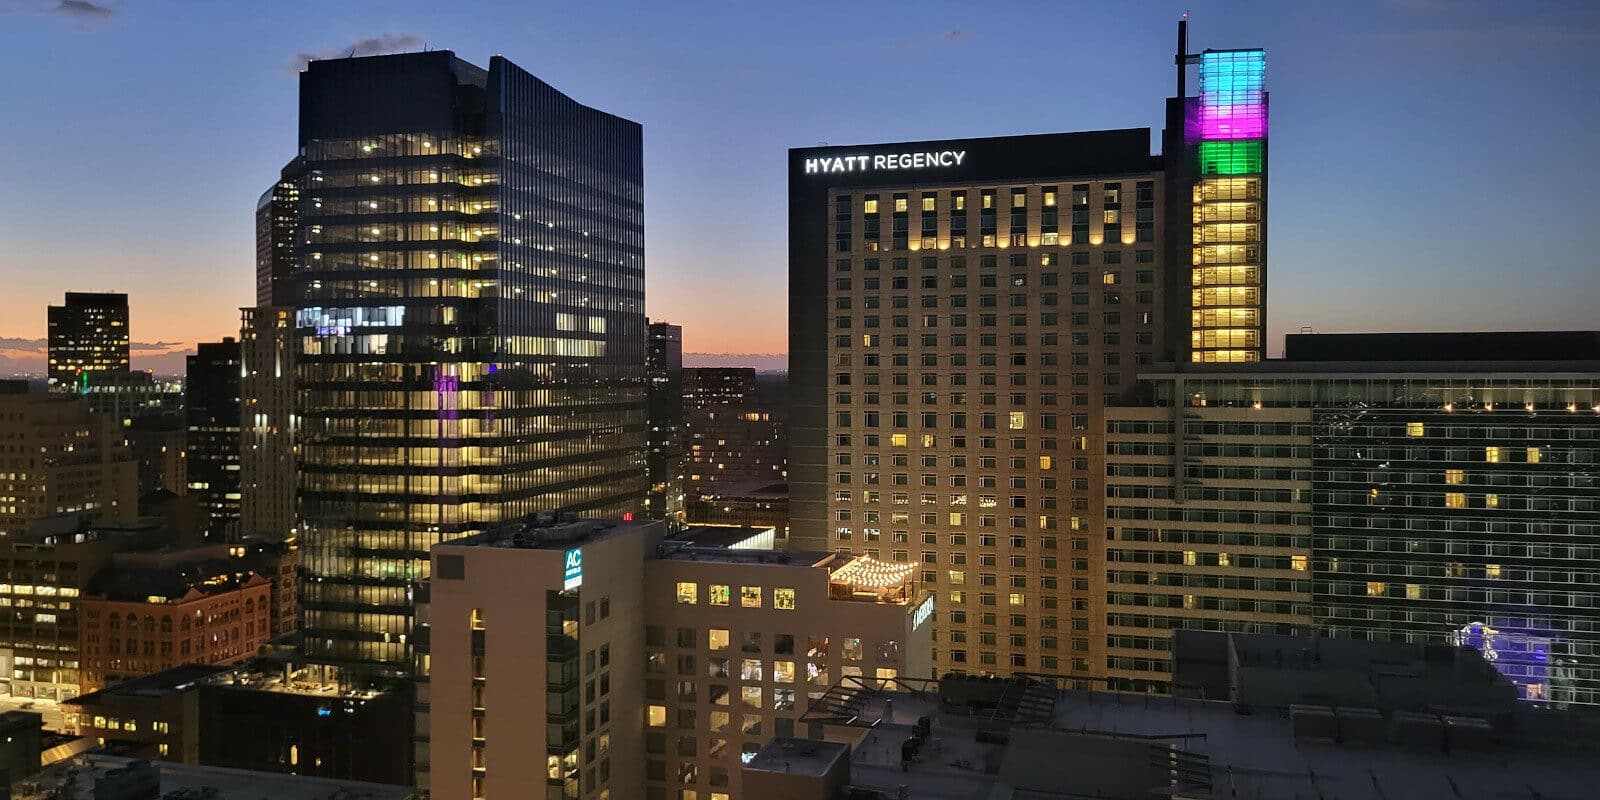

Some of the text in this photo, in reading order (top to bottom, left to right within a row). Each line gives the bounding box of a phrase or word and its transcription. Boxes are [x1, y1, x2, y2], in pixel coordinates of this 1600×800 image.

[805, 150, 966, 174] HYATT REGENCY
[566, 549, 581, 569] AC
